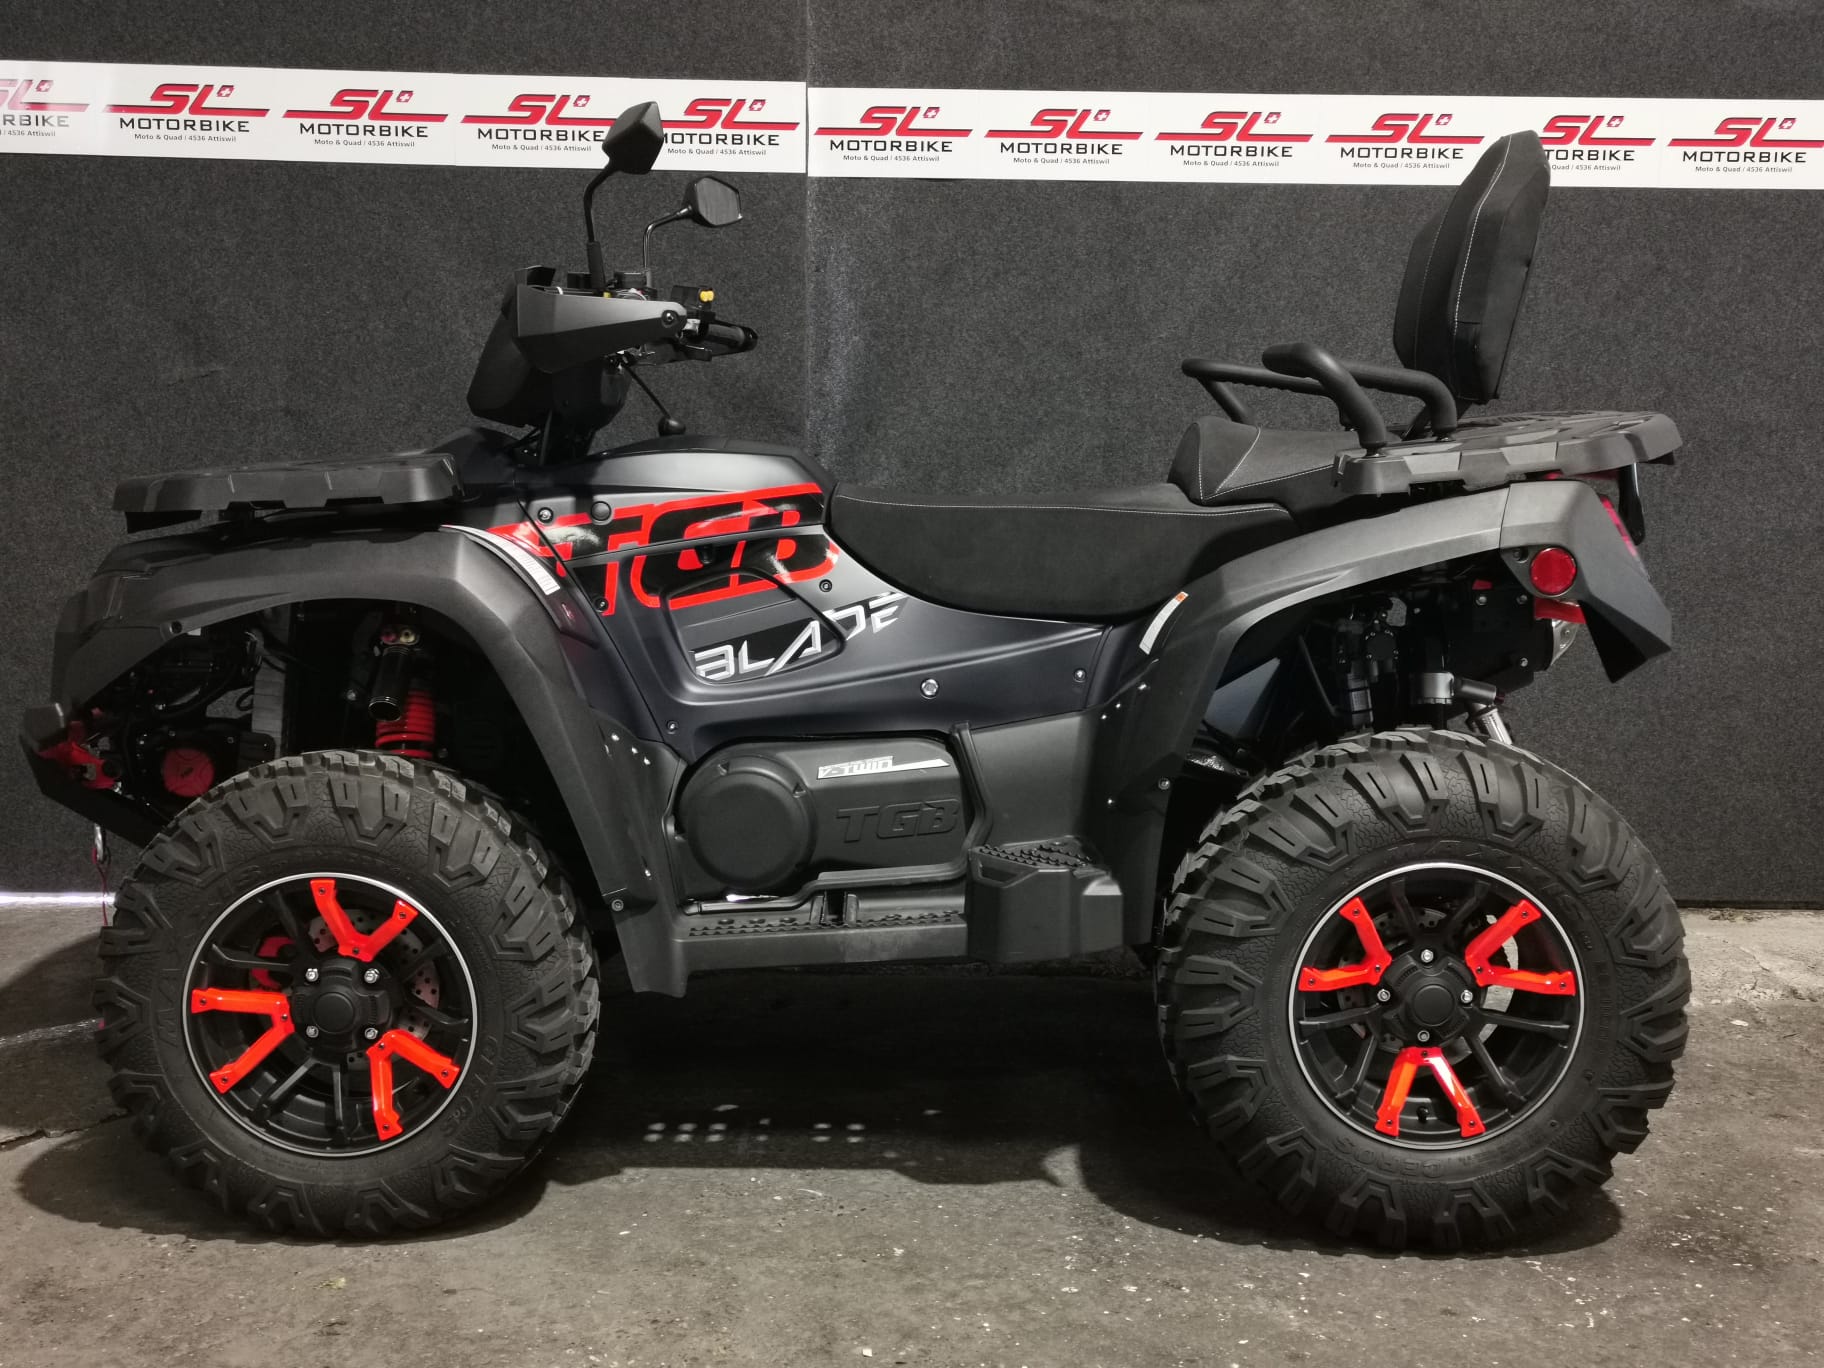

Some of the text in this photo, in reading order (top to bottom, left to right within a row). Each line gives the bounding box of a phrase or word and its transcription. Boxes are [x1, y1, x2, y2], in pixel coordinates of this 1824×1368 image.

[3, 114, 69, 127] RBIKE
[120, 118, 249, 132] MOTORBIKE
[300, 123, 428, 137] MOTORBIKE
[478, 128, 604, 142] MOTORBIKE
[830, 140, 952, 152] MOTORBIKE
[1000, 142, 1122, 155] MOTORBIKE
[1170, 145, 1292, 157] MOTORBIKE
[1341, 147, 1463, 159] MOTORBIKE
[1545, 149, 1634, 161] TORBIKE
[1683, 151, 1806, 163] MOTORBIKE
[486, 482, 842, 616] TGB
[692, 590, 911, 683] BLADE
[836, 798, 960, 844] TGB
